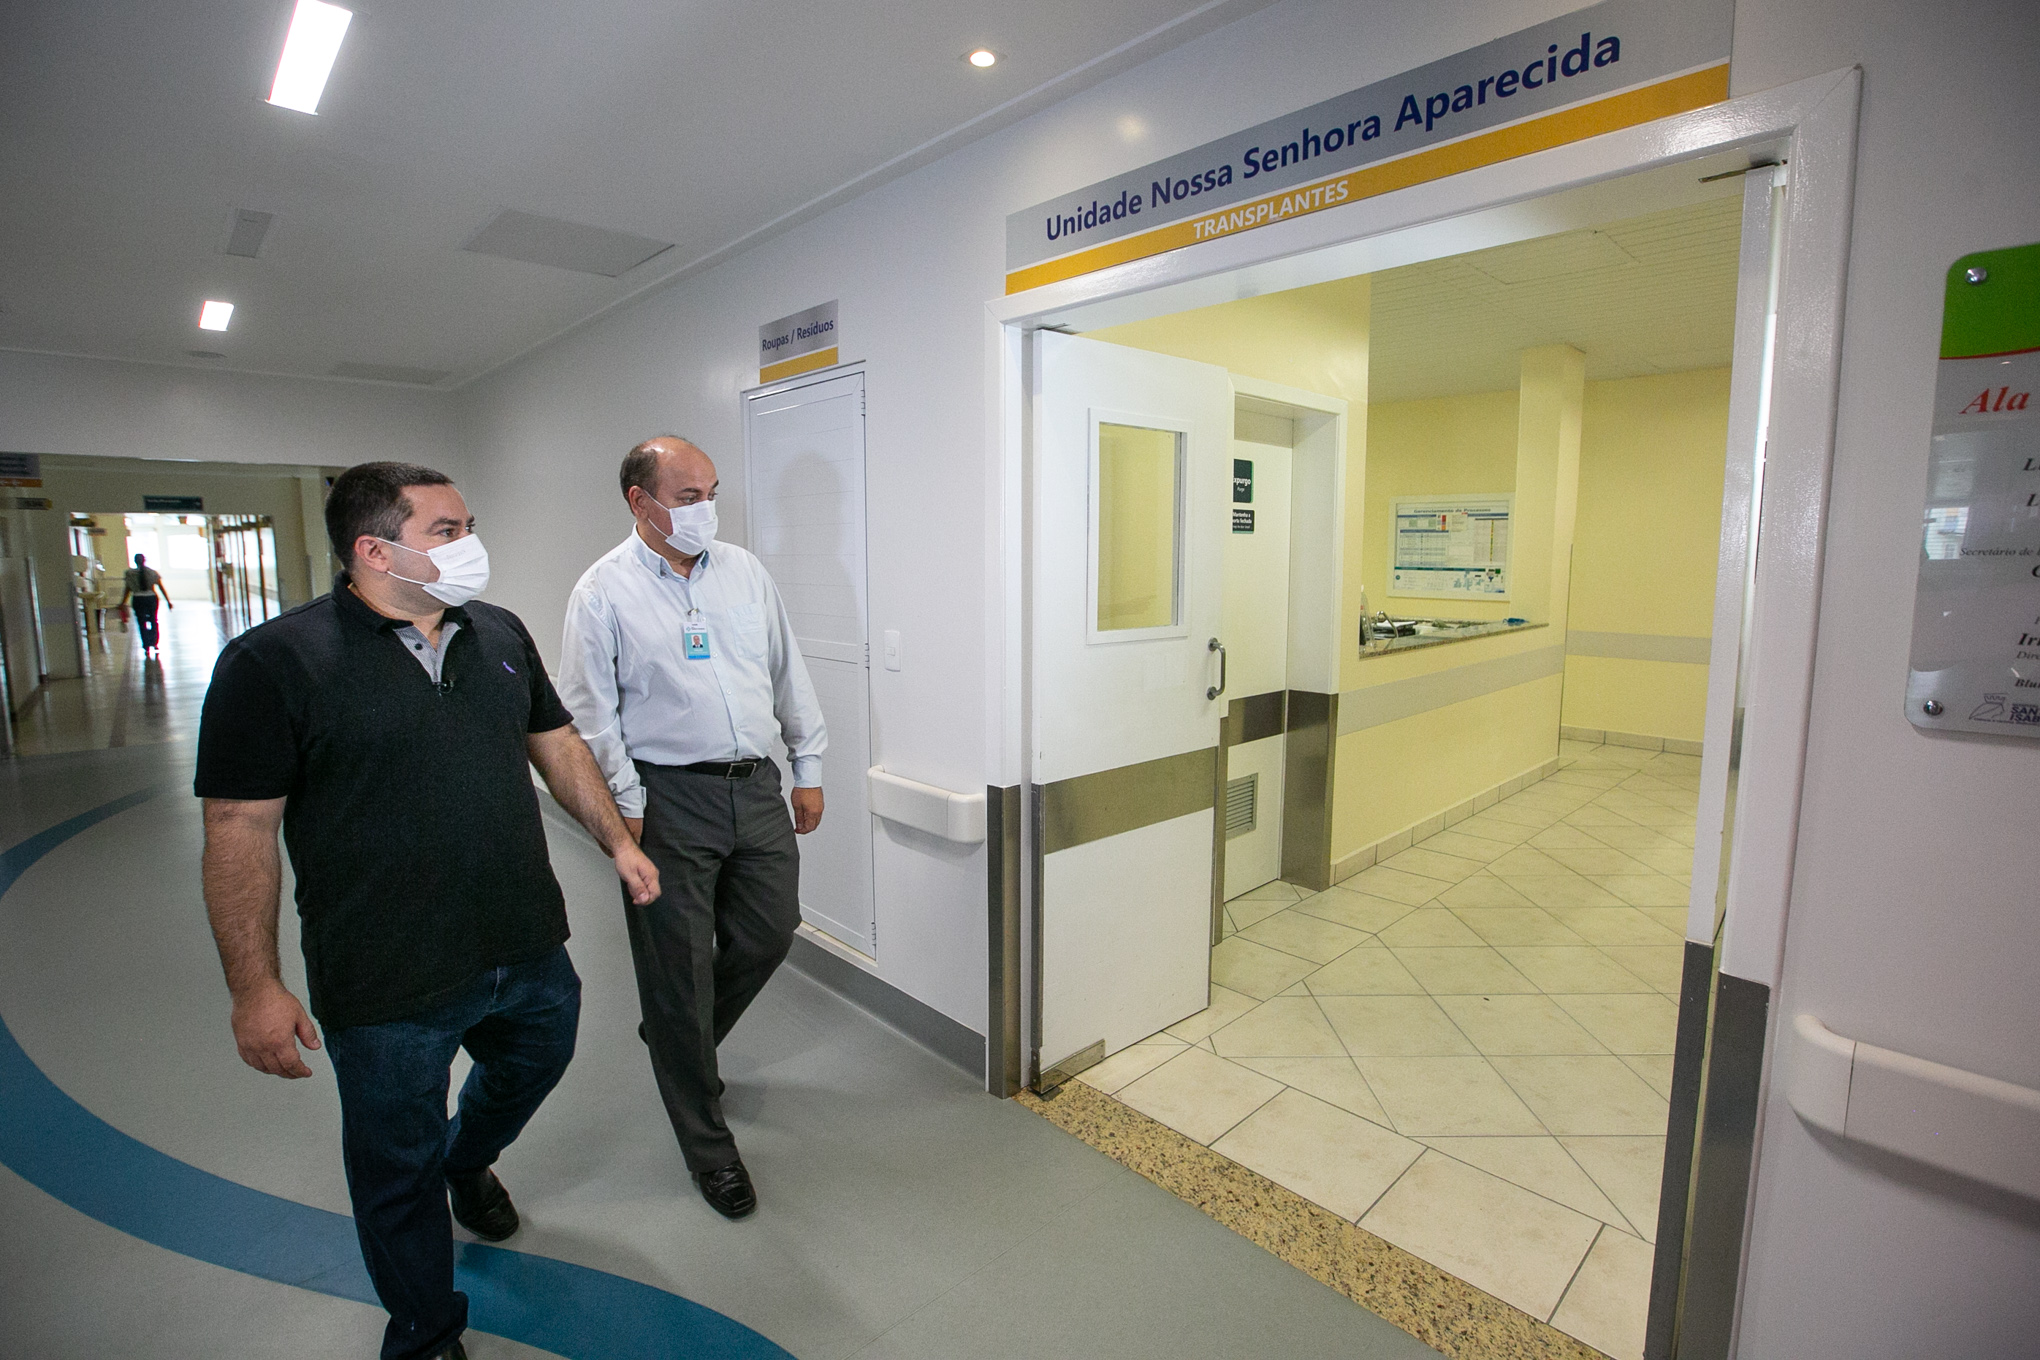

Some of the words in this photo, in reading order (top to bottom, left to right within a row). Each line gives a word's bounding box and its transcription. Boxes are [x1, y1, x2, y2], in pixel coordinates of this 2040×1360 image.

[1046, 190, 1142, 241] Unidade
[1151, 164, 1233, 208] Nossa
[1243, 115, 1381, 179] Senhora
[1393, 32, 1621, 132] Aparecida
[1193, 180, 1349, 239] TRANSPLANTES
[762, 334, 789, 351] Roupas
[790, 329, 795, 344] /
[797, 320, 834, 341] Resíduos
[1958, 386, 2030, 414] Ala
[1960, 546, 2016, 556] Secretário
[2018, 547, 2033, 556] de
